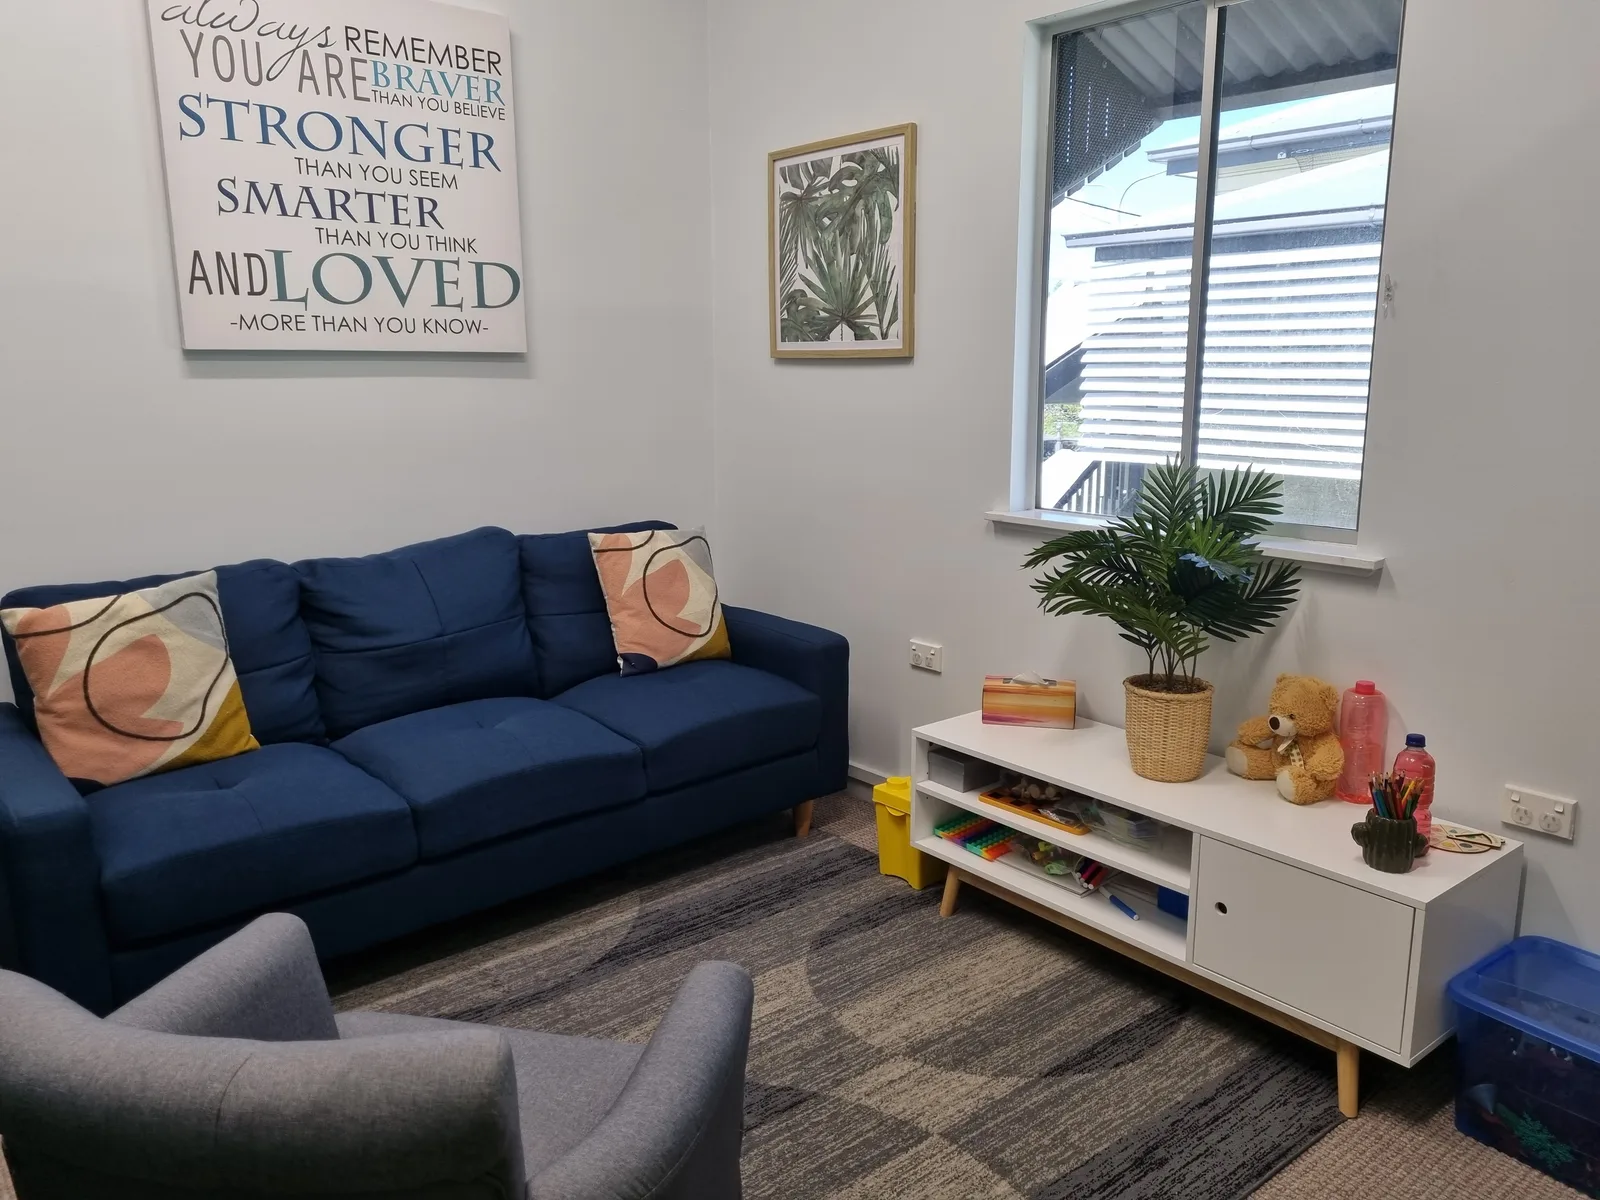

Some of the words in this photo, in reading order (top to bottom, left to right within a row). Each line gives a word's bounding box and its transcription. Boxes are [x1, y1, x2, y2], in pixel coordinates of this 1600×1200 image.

[160, 0, 336, 82] always
[345, 25, 502, 76] REMEMBER
[180, 29, 261, 87] YOU
[298, 50, 371, 103] ARE
[371, 59, 505, 106] BRAVER
[178, 92, 502, 172] STRONGER
[371, 89, 413, 108] THAN
[417, 96, 449, 114] YOU
[454, 101, 506, 121] BELIEVE
[294, 157, 352, 180] THAN
[358, 163, 403, 185] YOU
[409, 169, 459, 190] SEEM
[217, 176, 445, 230] SMARTER
[315, 227, 371, 247] THAN
[377, 231, 420, 251] YOU
[426, 235, 478, 254] THINK
[188, 250, 268, 297] AND
[265, 249, 521, 312] LOVED
[230, 314, 306, 332] -MORE
[311, 315, 368, 333] THAN
[374, 316, 416, 334] YOU
[423, 318, 489, 335] KNOW-
